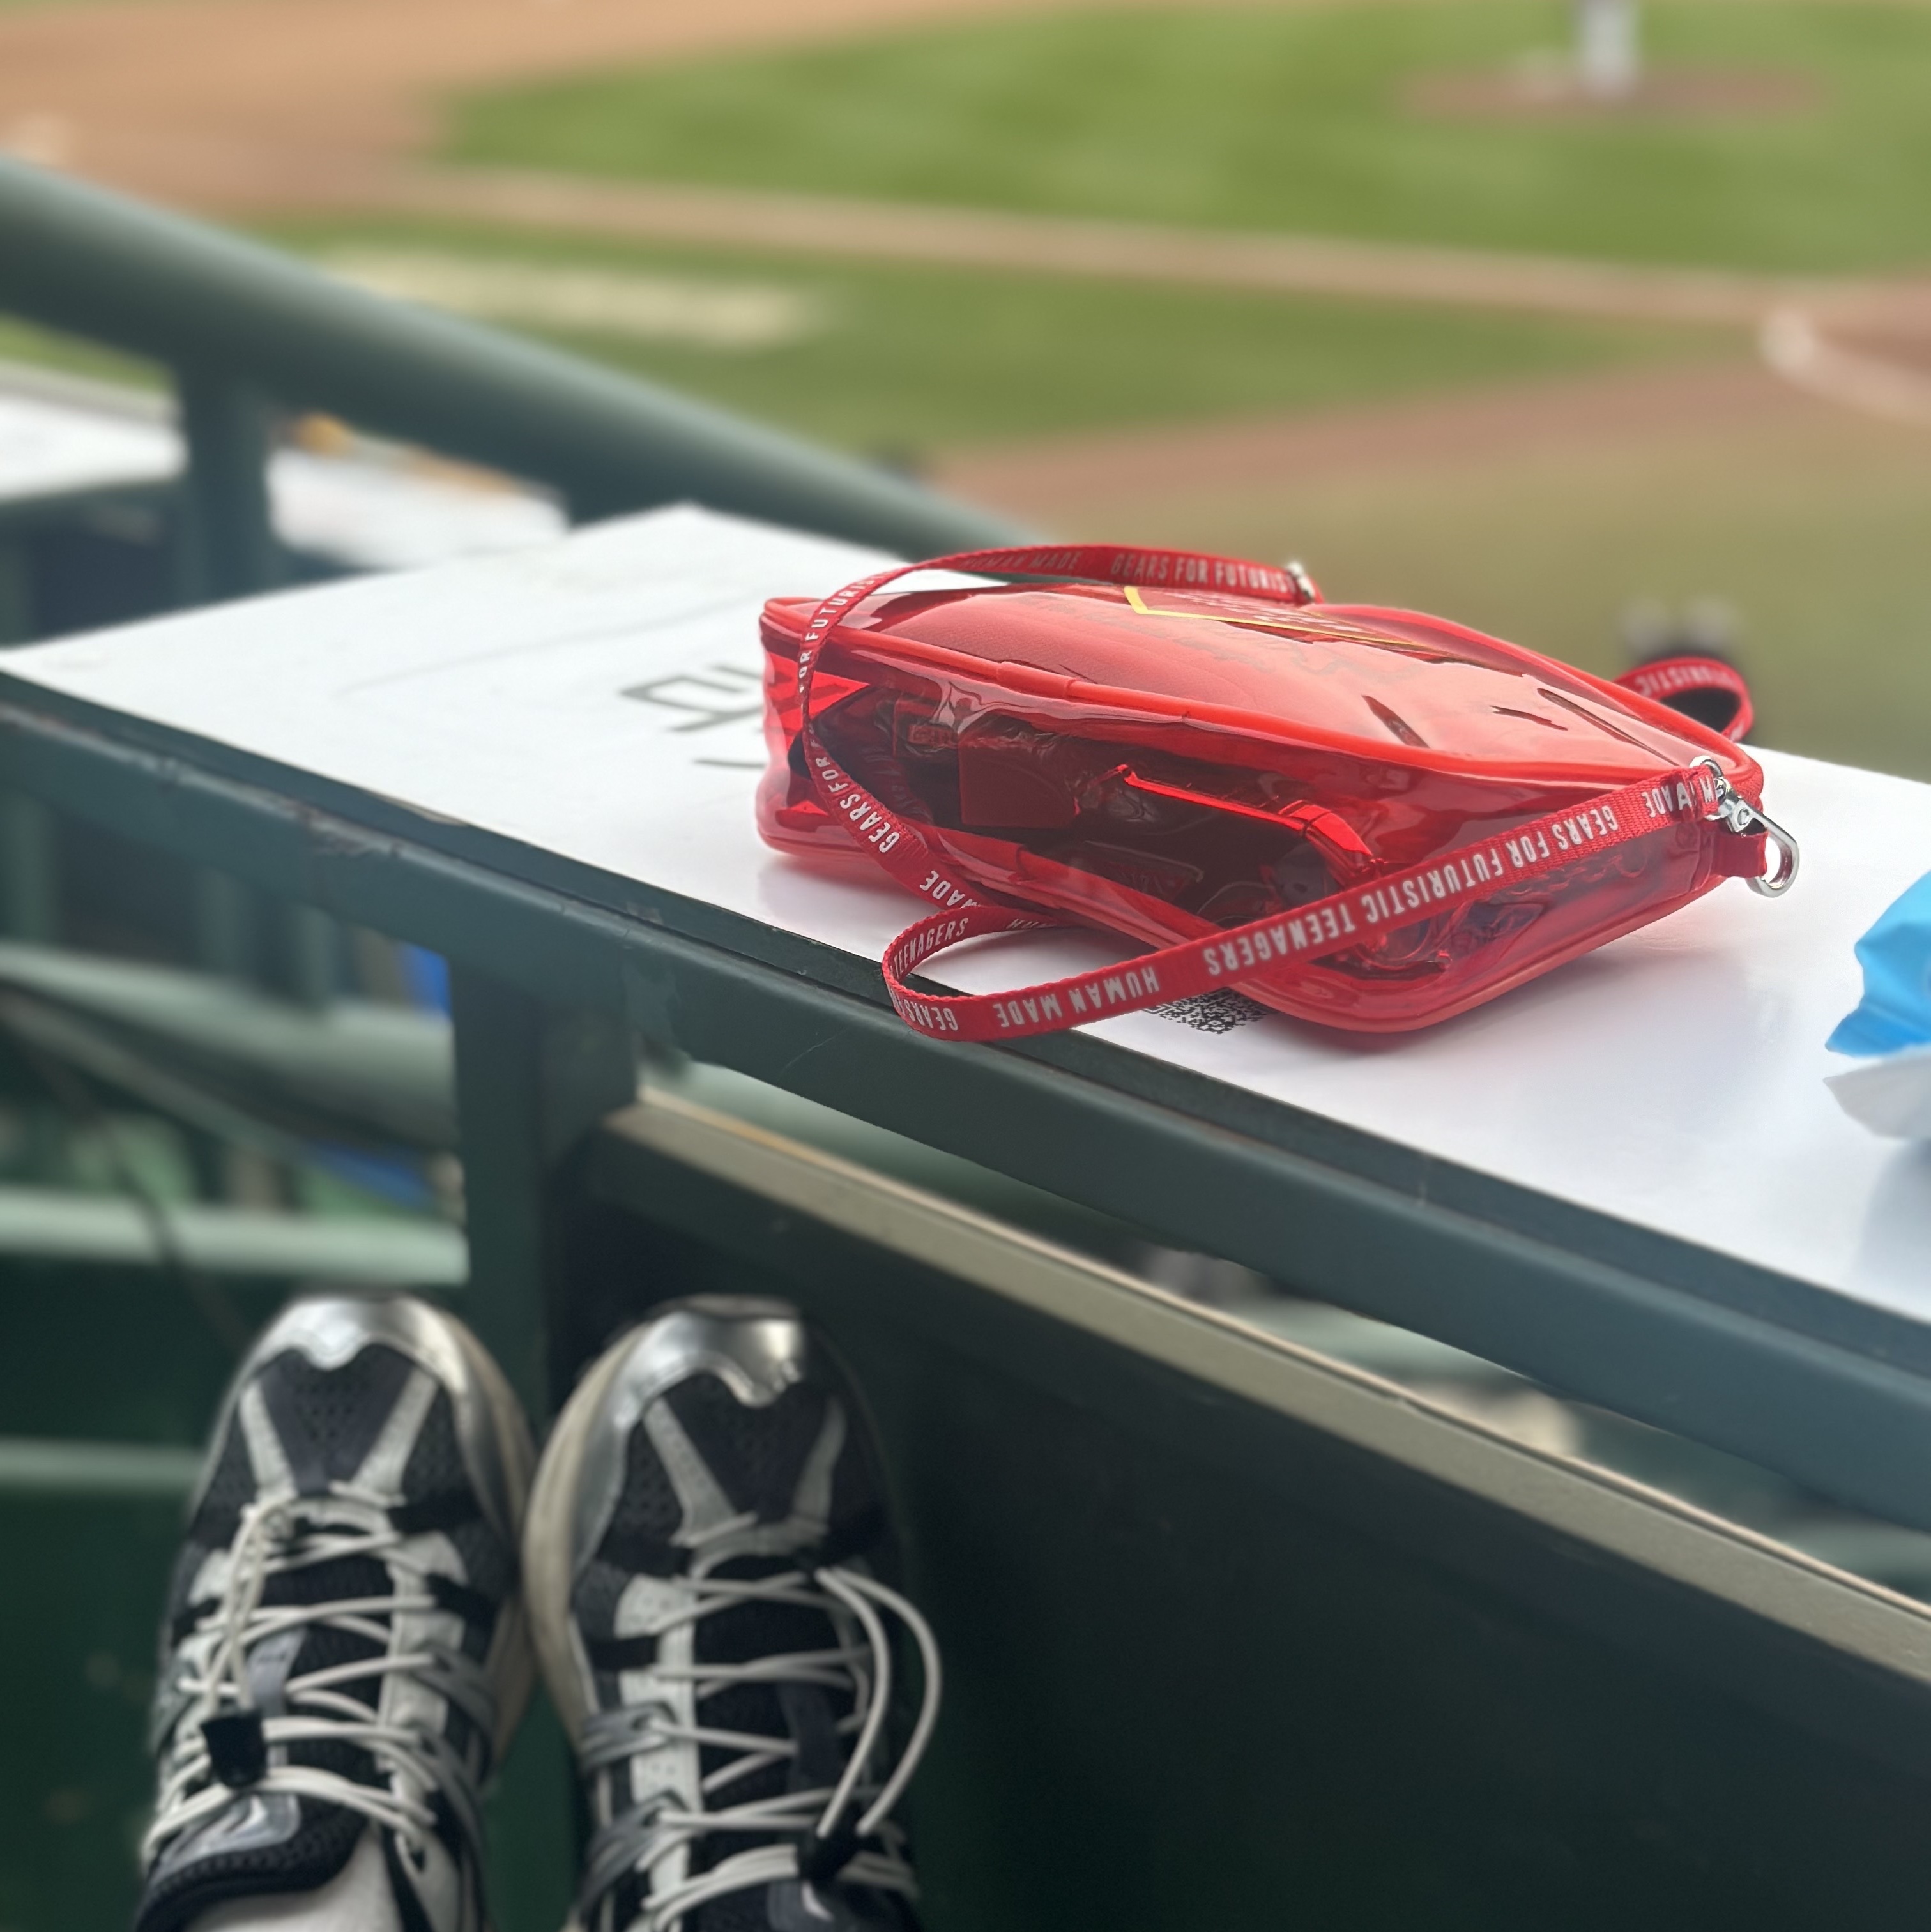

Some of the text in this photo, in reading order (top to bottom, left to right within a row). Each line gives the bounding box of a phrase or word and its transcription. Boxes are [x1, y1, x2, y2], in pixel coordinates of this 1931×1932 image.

[1028, 551, 1083, 569] MADE
[1111, 553, 1170, 580] GEARS
[1174, 556, 1209, 583] FOR
[815, 756, 849, 793] FOR
[840, 793, 900, 853] GEARS
[1552, 805, 1619, 850] GEARS
[1506, 831, 1550, 868] FOR
[1361, 848, 1504, 924] FUTURISTIC
[894, 918, 968, 980] TEENAGERS
[1203, 904, 1356, 976] TEENAGERS
[993, 994, 1063, 1028] MADE
[1069, 966, 1159, 1014] HUMAN
[903, 998, 958, 1031] GEARS
